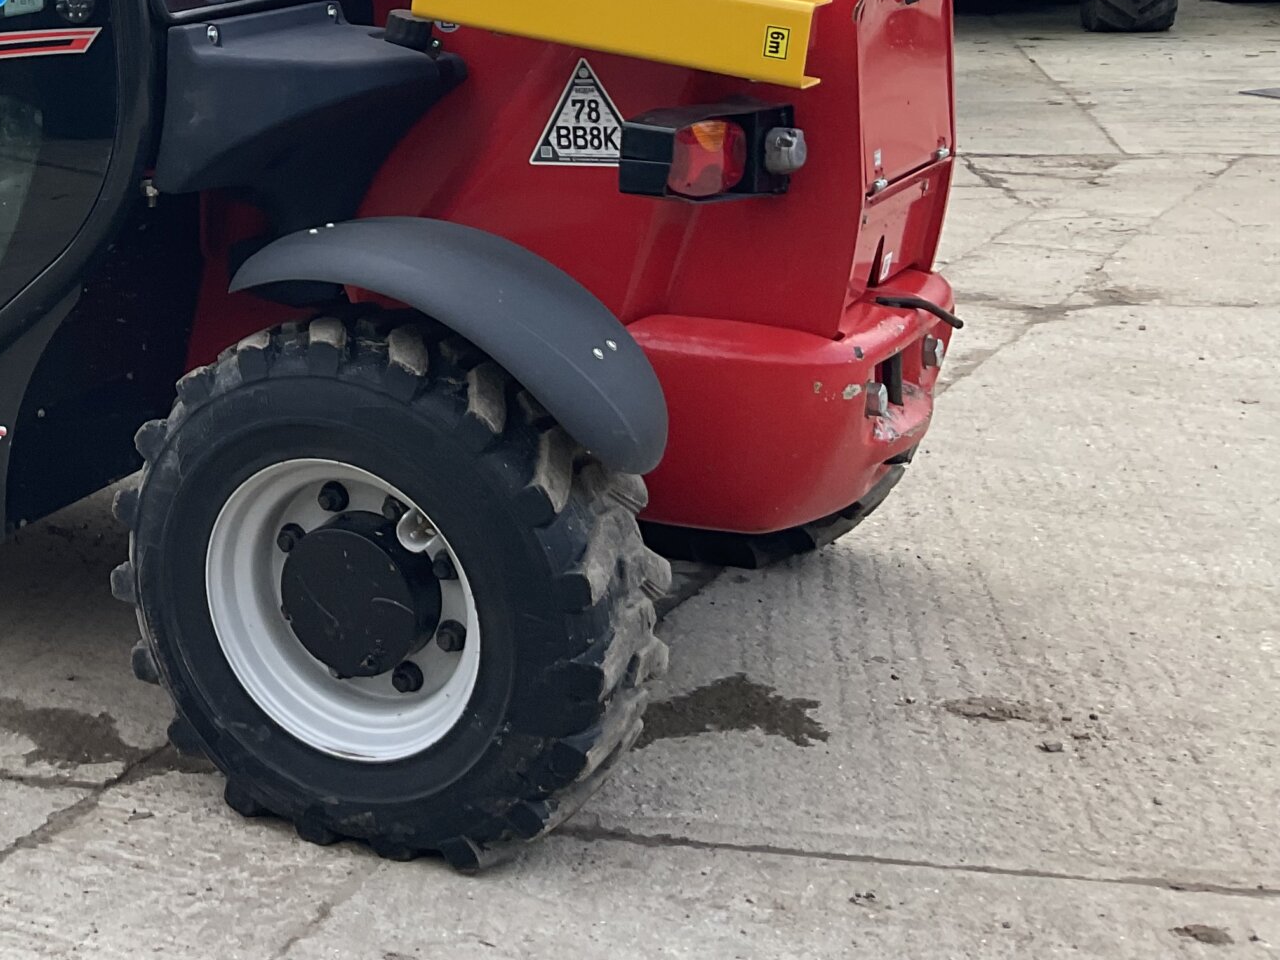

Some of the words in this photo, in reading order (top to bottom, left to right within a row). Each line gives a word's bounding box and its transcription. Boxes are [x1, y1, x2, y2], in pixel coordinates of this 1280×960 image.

[768, 31, 785, 54] 6m
[571, 99, 600, 123] 78
[555, 125, 621, 151] BB8K
